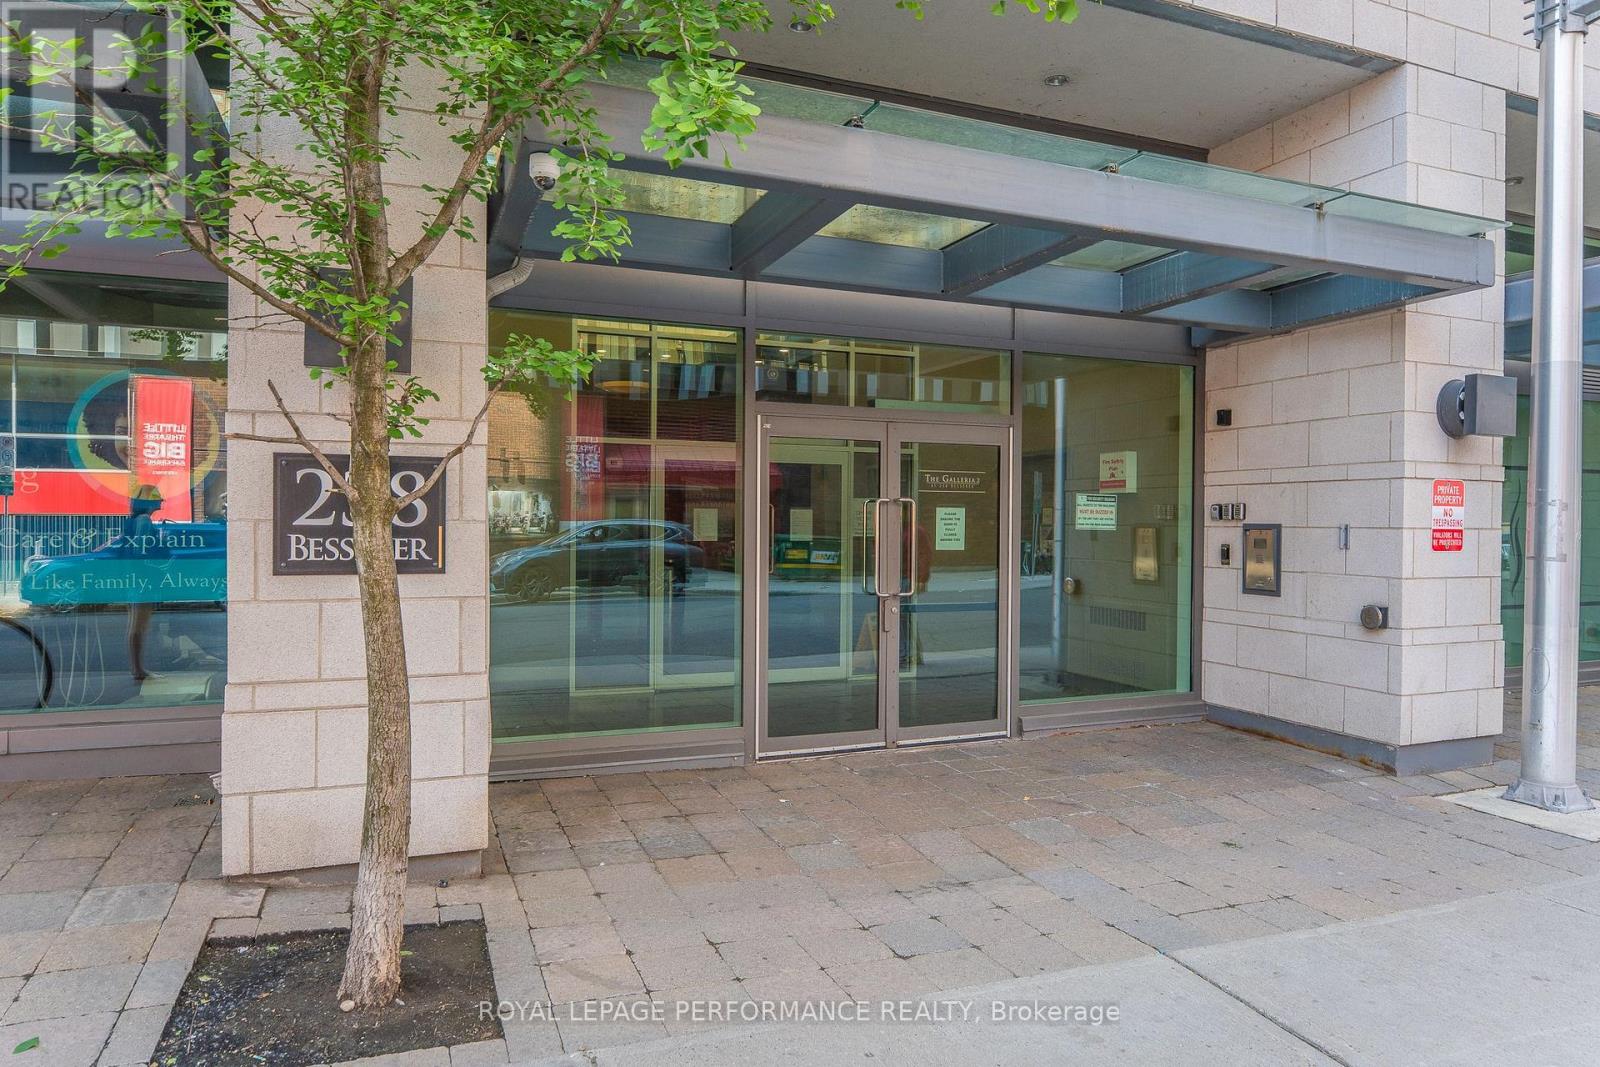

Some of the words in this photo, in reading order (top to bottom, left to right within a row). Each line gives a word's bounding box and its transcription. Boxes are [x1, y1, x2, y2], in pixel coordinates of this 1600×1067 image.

[292, 468, 428, 527] 28
[1437, 485, 1460, 495] PRIVATE
[1434, 495, 1463, 505] PROPERTY
[1443, 508, 1453, 517] NO
[1433, 519, 1463, 528] TRESPASSING
[105, 527, 206, 555] Explain
[287, 534, 432, 561] BESSER
[30, 573, 75, 590] Like
[82, 573, 153, 593] Family,
